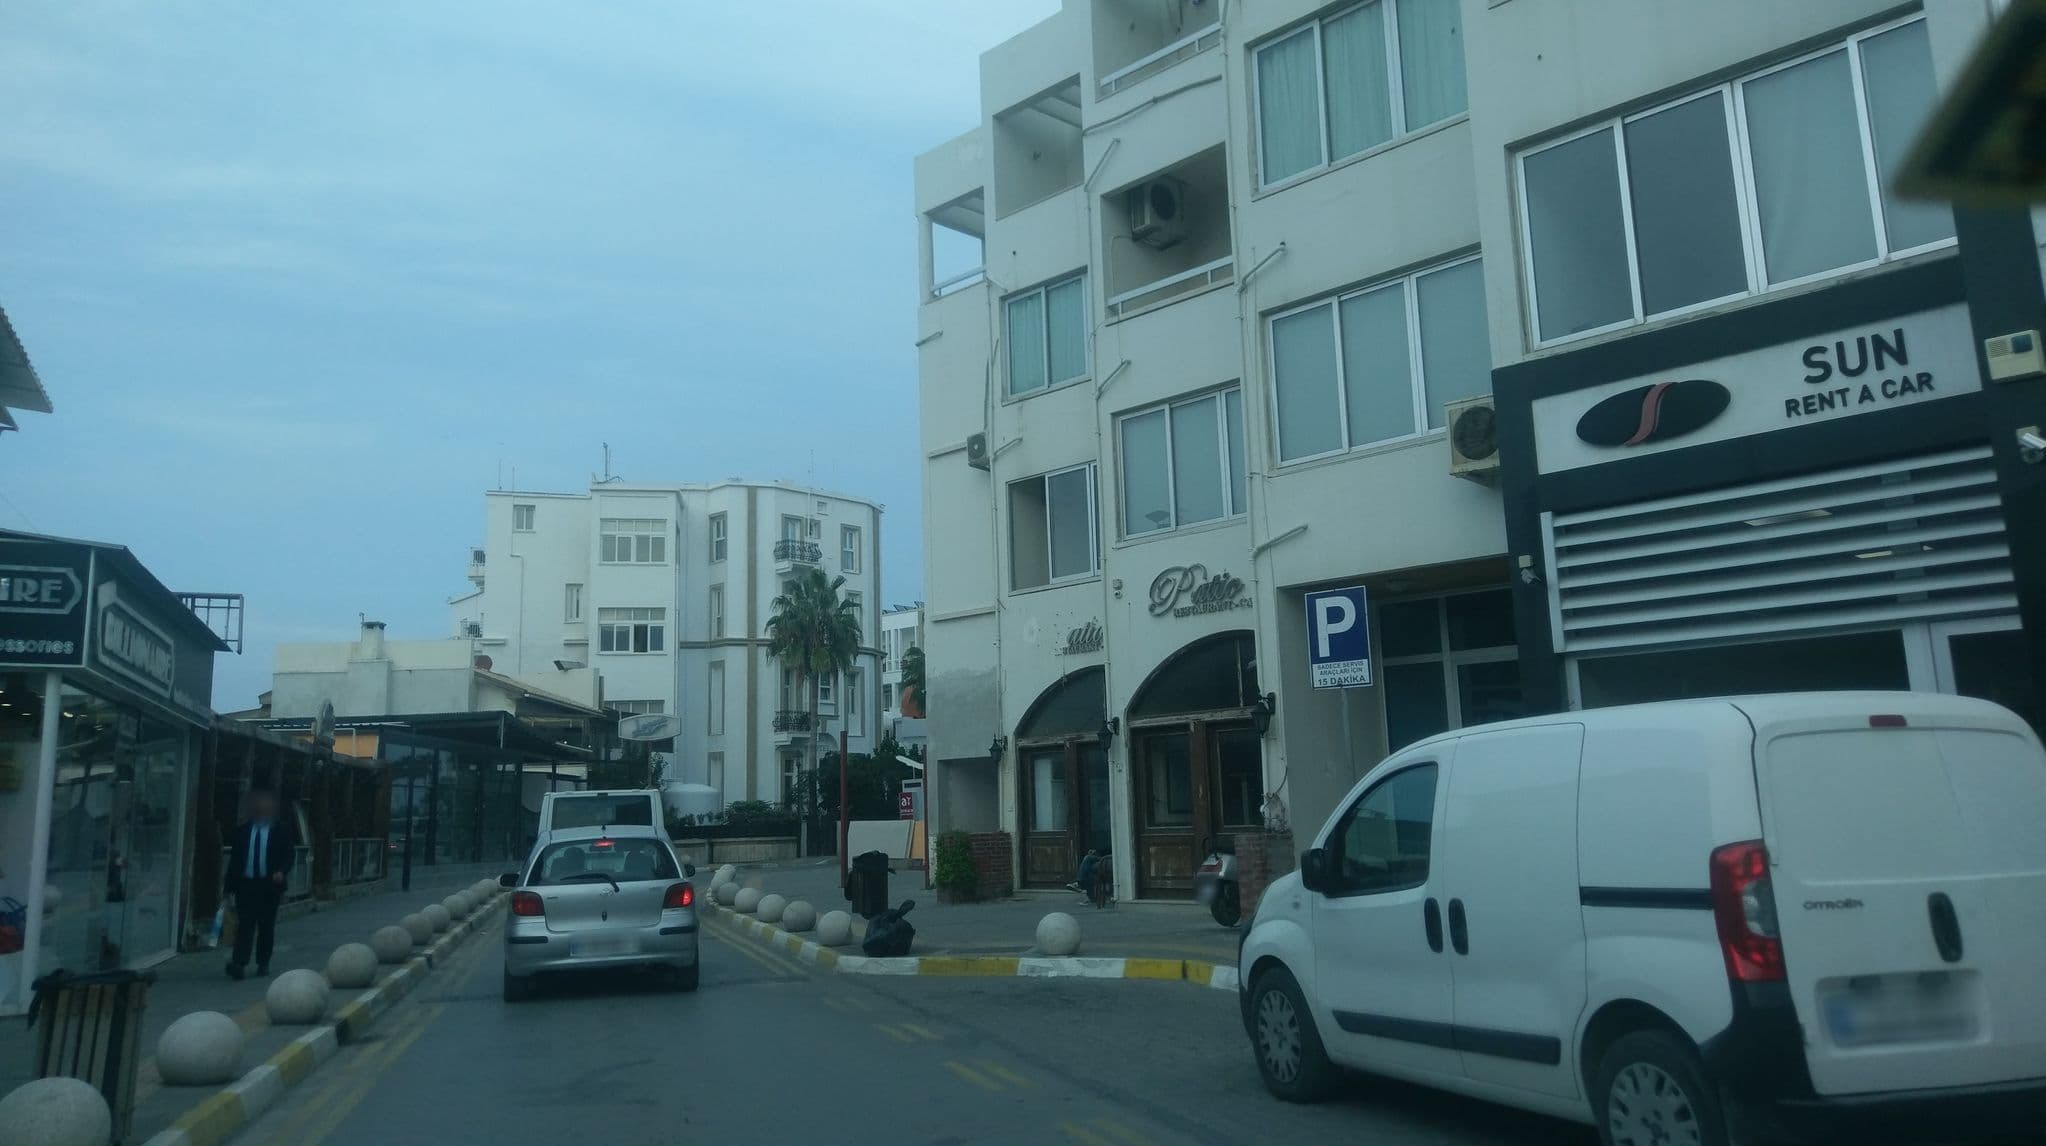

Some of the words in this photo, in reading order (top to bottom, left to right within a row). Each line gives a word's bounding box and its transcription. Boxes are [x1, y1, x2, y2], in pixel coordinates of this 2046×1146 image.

[1802, 328, 1908, 383] SUN
[1785, 387, 1850, 417] RENT
[1858, 384, 1875, 404] A
[1881, 372, 1935, 399] CAR
[1148, 563, 1245, 617] Patio
[1315, 596, 1356, 658] P
[1330, 674, 1365, 685] DAKİKA
